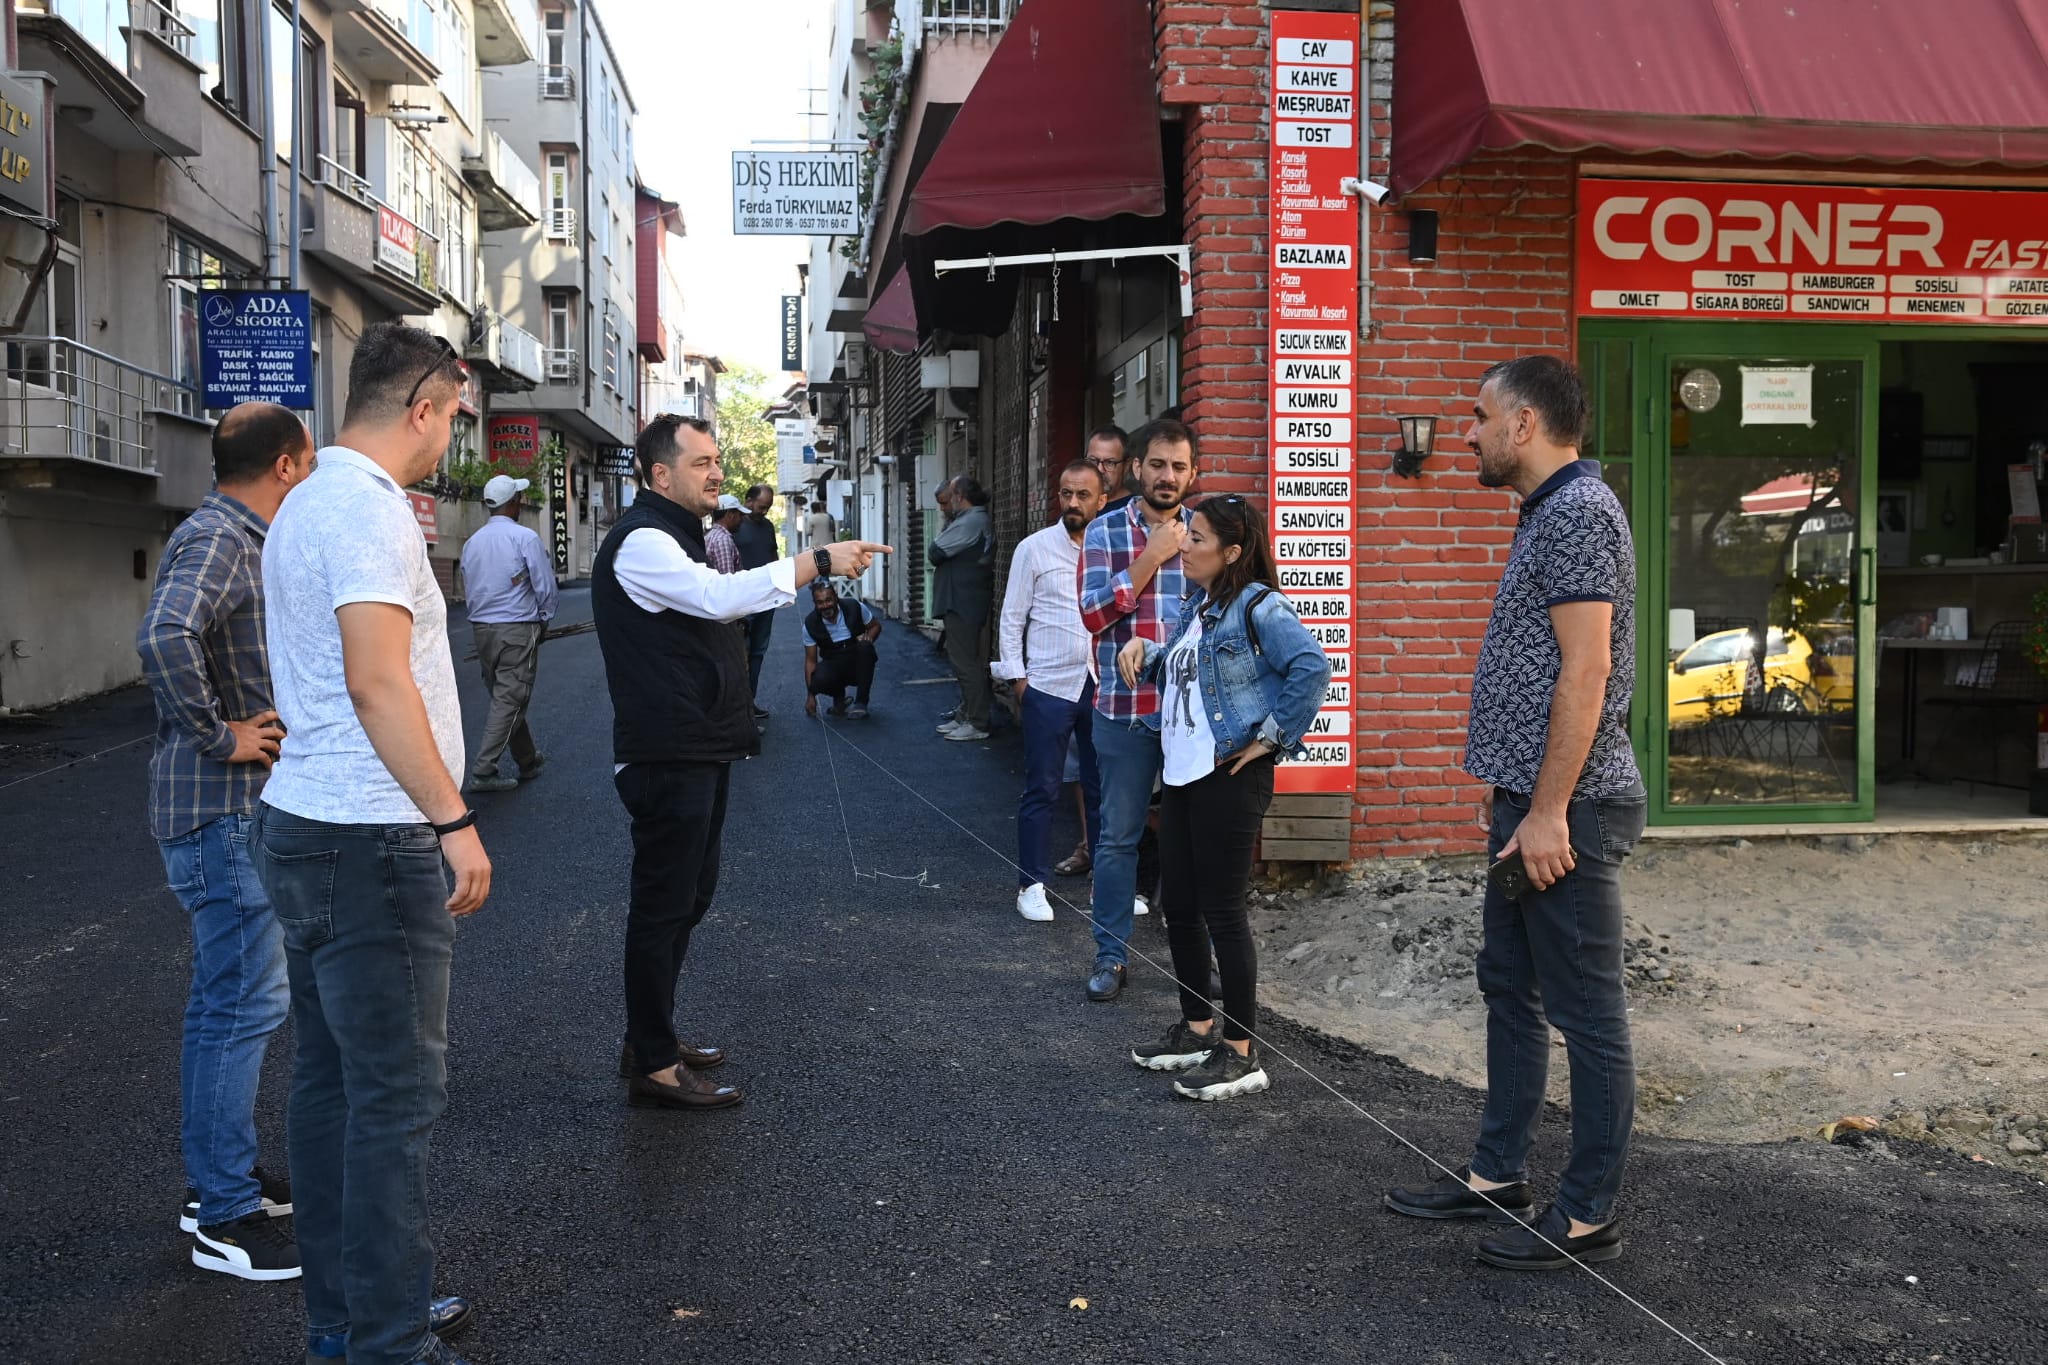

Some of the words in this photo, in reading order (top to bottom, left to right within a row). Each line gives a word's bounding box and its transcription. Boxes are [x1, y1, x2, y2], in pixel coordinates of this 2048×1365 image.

[1301, 41, 1328, 61] ÇAY
[1291, 70, 1338, 87] KAHVE
[1278, 95, 1351, 116] MEŞRUBAT
[1297, 127, 1332, 143] TOST
[736, 154, 772, 194] DİŞ
[778, 154, 854, 187] HEKİMİ
[739, 199, 772, 214] Ferda
[775, 195, 853, 215] TÜRKYILMAZ
[743, 218, 759, 228] 0282
[841, 219, 849, 229] 47
[1281, 224, 1307, 238] Dürüm
[1593, 196, 1945, 268] CORNER
[1280, 248, 1346, 265] BAZLAMA
[1280, 272, 1301, 286] Pizza
[1725, 273, 1756, 287] TOST
[1802, 275, 1876, 290] HAMBURGER
[1915, 277, 1959, 293] SOSİSLİ
[244, 297, 291, 313] ADA
[1619, 293, 1660, 307] OMLET
[1695, 293, 1739, 310] SİGARA
[1742, 294, 1784, 311] BÖREĞİ
[1807, 297, 1870, 311] SANDWICH
[1907, 300, 1965, 313] MENEMEN
[786, 297, 797, 324] CAFE
[235, 314, 304, 328] SİGORTA
[207, 329, 248, 337] ARACILIK
[251, 329, 304, 338] HİZMETLERİ
[1280, 334, 1311, 349] SUCUK
[1314, 334, 1346, 350] EKMEK
[217, 349, 253, 359] TRAFİK
[261, 351, 294, 359] KASKO
[222, 362, 249, 370] DASK
[257, 362, 293, 370] YANGIN
[1285, 364, 1341, 380] AYVALIK
[219, 371, 251, 382] İŞYERİ
[259, 371, 294, 381] SAĞLIK
[207, 384, 251, 392] SEYAHAT
[260, 382, 306, 393] NAKLİYAT
[233, 395, 281, 404] HIRSIZLIK
[1288, 392, 1338, 408] KUMRU
[1288, 422, 1332, 438] PATSO
[492, 439, 533, 450] EMAK
[1288, 448, 1339, 467] SOSİSLİ
[1277, 481, 1348, 497] HAMBURGER
[1281, 509, 1344, 528] SANDVİCH
[1280, 542, 1295, 558] EV
[1298, 538, 1346, 558] KÖFTESİ
[1281, 568, 1344, 587] GÖZLEME
[1291, 600, 1319, 616] ARA
[1322, 597, 1348, 616] BÖR.
[1326, 625, 1348, 643] BÖR.
[1304, 743, 1347, 765] ĞAÇASI
